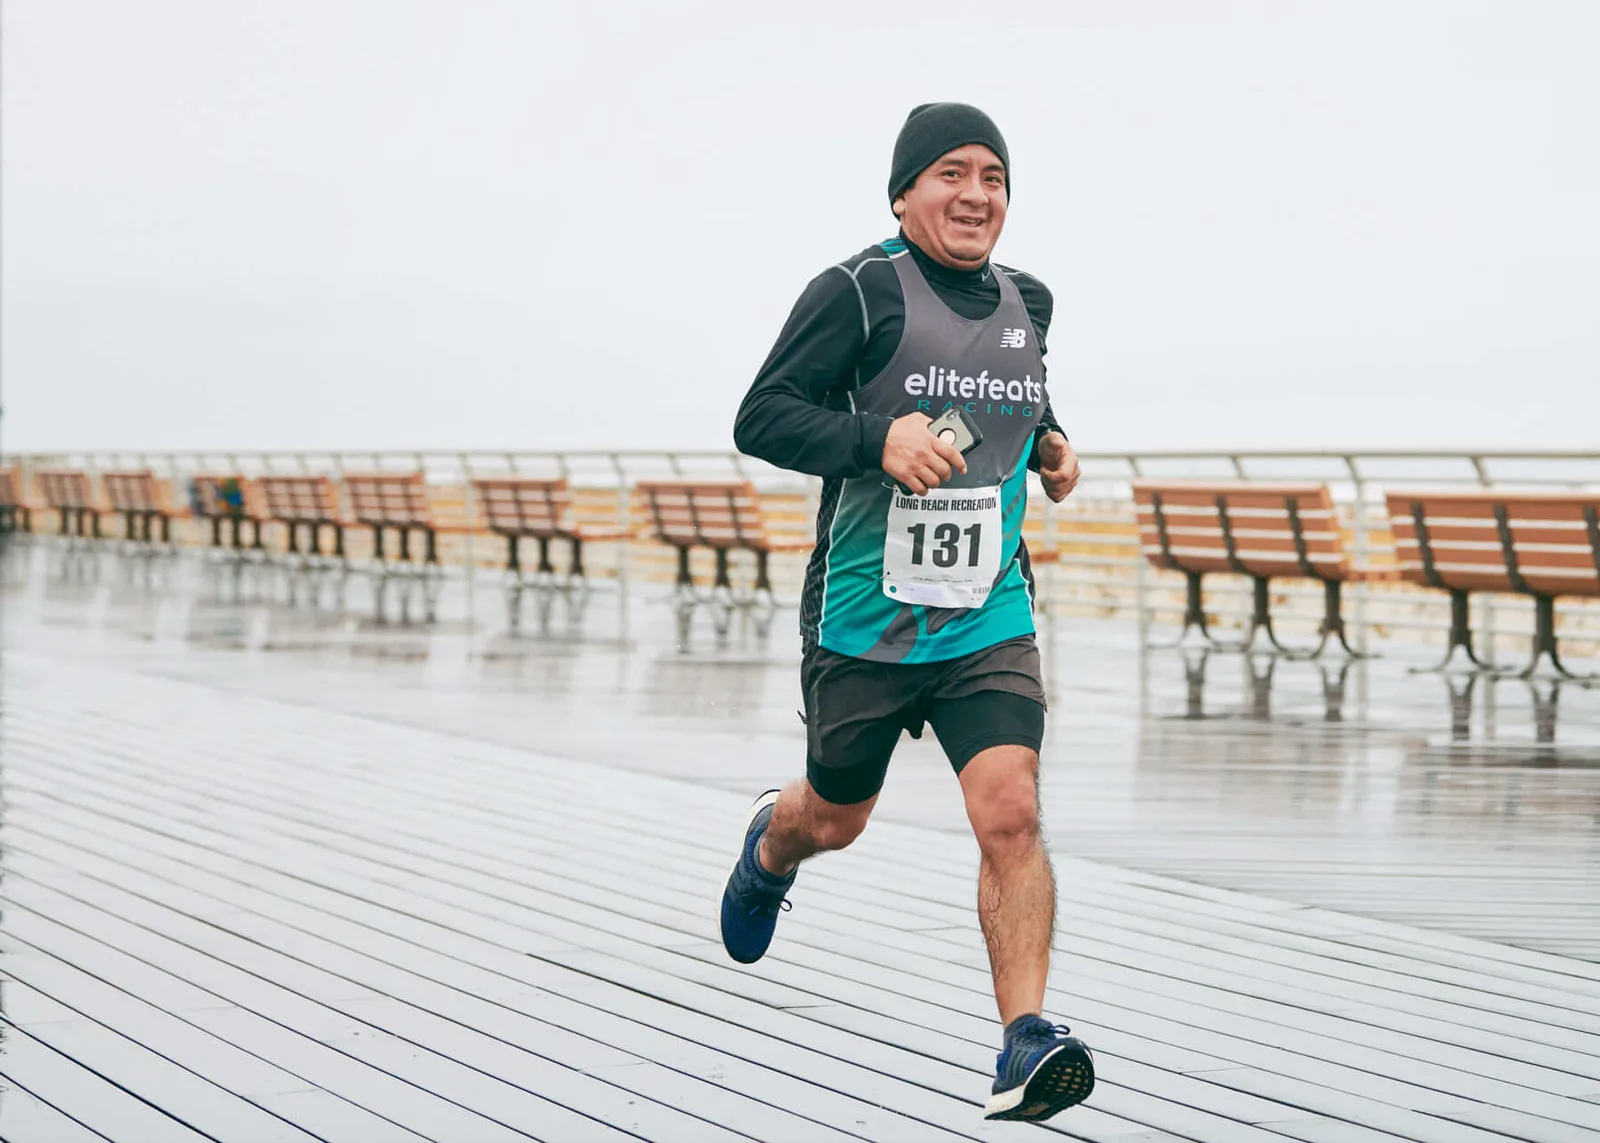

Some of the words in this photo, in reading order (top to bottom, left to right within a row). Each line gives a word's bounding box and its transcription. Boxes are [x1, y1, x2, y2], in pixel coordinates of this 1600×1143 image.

[904, 365, 1041, 404] elitefeats
[896, 496, 919, 511] LONG
[921, 498, 949, 511] BEACH
[951, 497, 996, 511] RECREATION
[907, 523, 981, 568] 131
